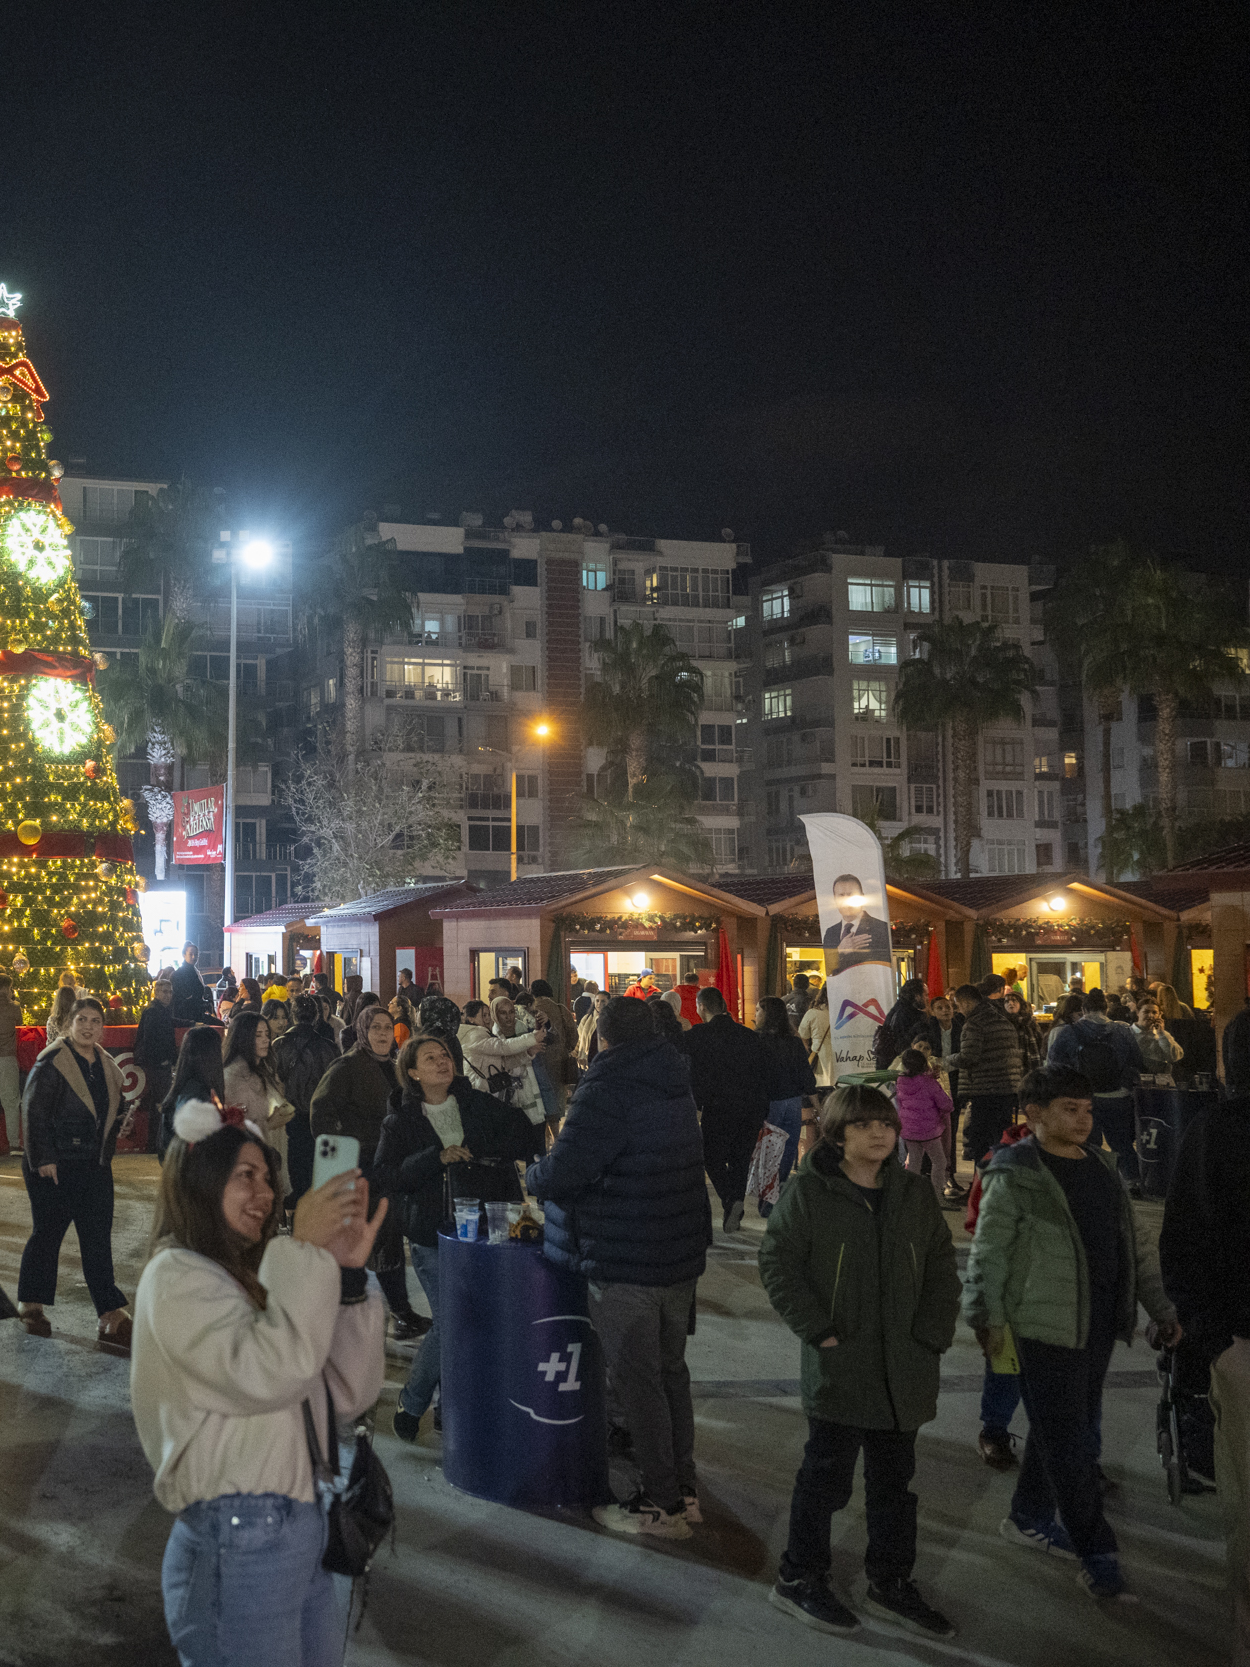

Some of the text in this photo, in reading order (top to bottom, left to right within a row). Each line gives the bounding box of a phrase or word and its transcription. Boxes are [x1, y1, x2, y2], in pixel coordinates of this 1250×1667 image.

[835, 1049, 865, 1067] Vahap
[1140, 1128, 1158, 1149] +1
[537, 1342, 582, 1391] +1
